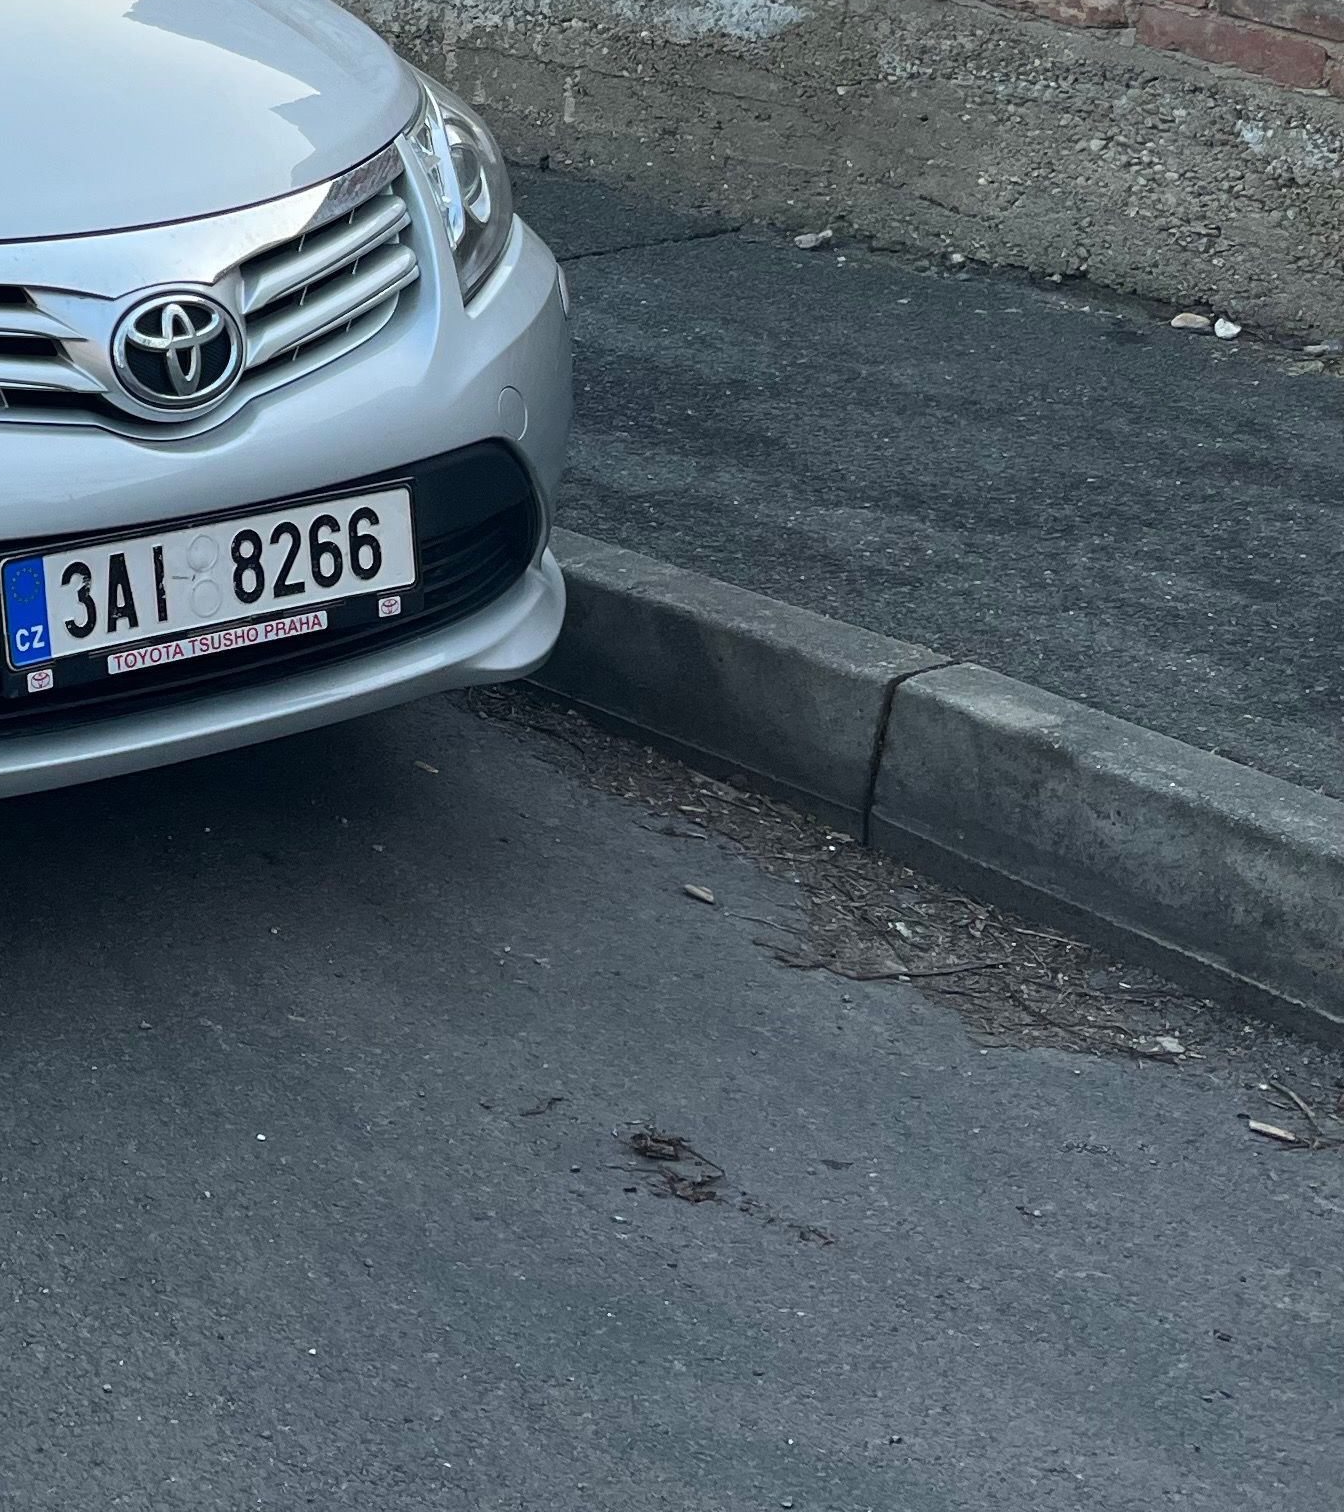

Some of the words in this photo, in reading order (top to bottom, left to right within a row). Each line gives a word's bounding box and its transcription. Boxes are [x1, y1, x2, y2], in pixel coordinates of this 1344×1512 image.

[60, 544, 169, 639] 3AI
[230, 505, 383, 605] 8266
[15, 624, 46, 653] CZ
[113, 644, 184, 671] TOYOTA
[188, 626, 259, 656] TSUSHO
[264, 612, 324, 639] PRAHA
